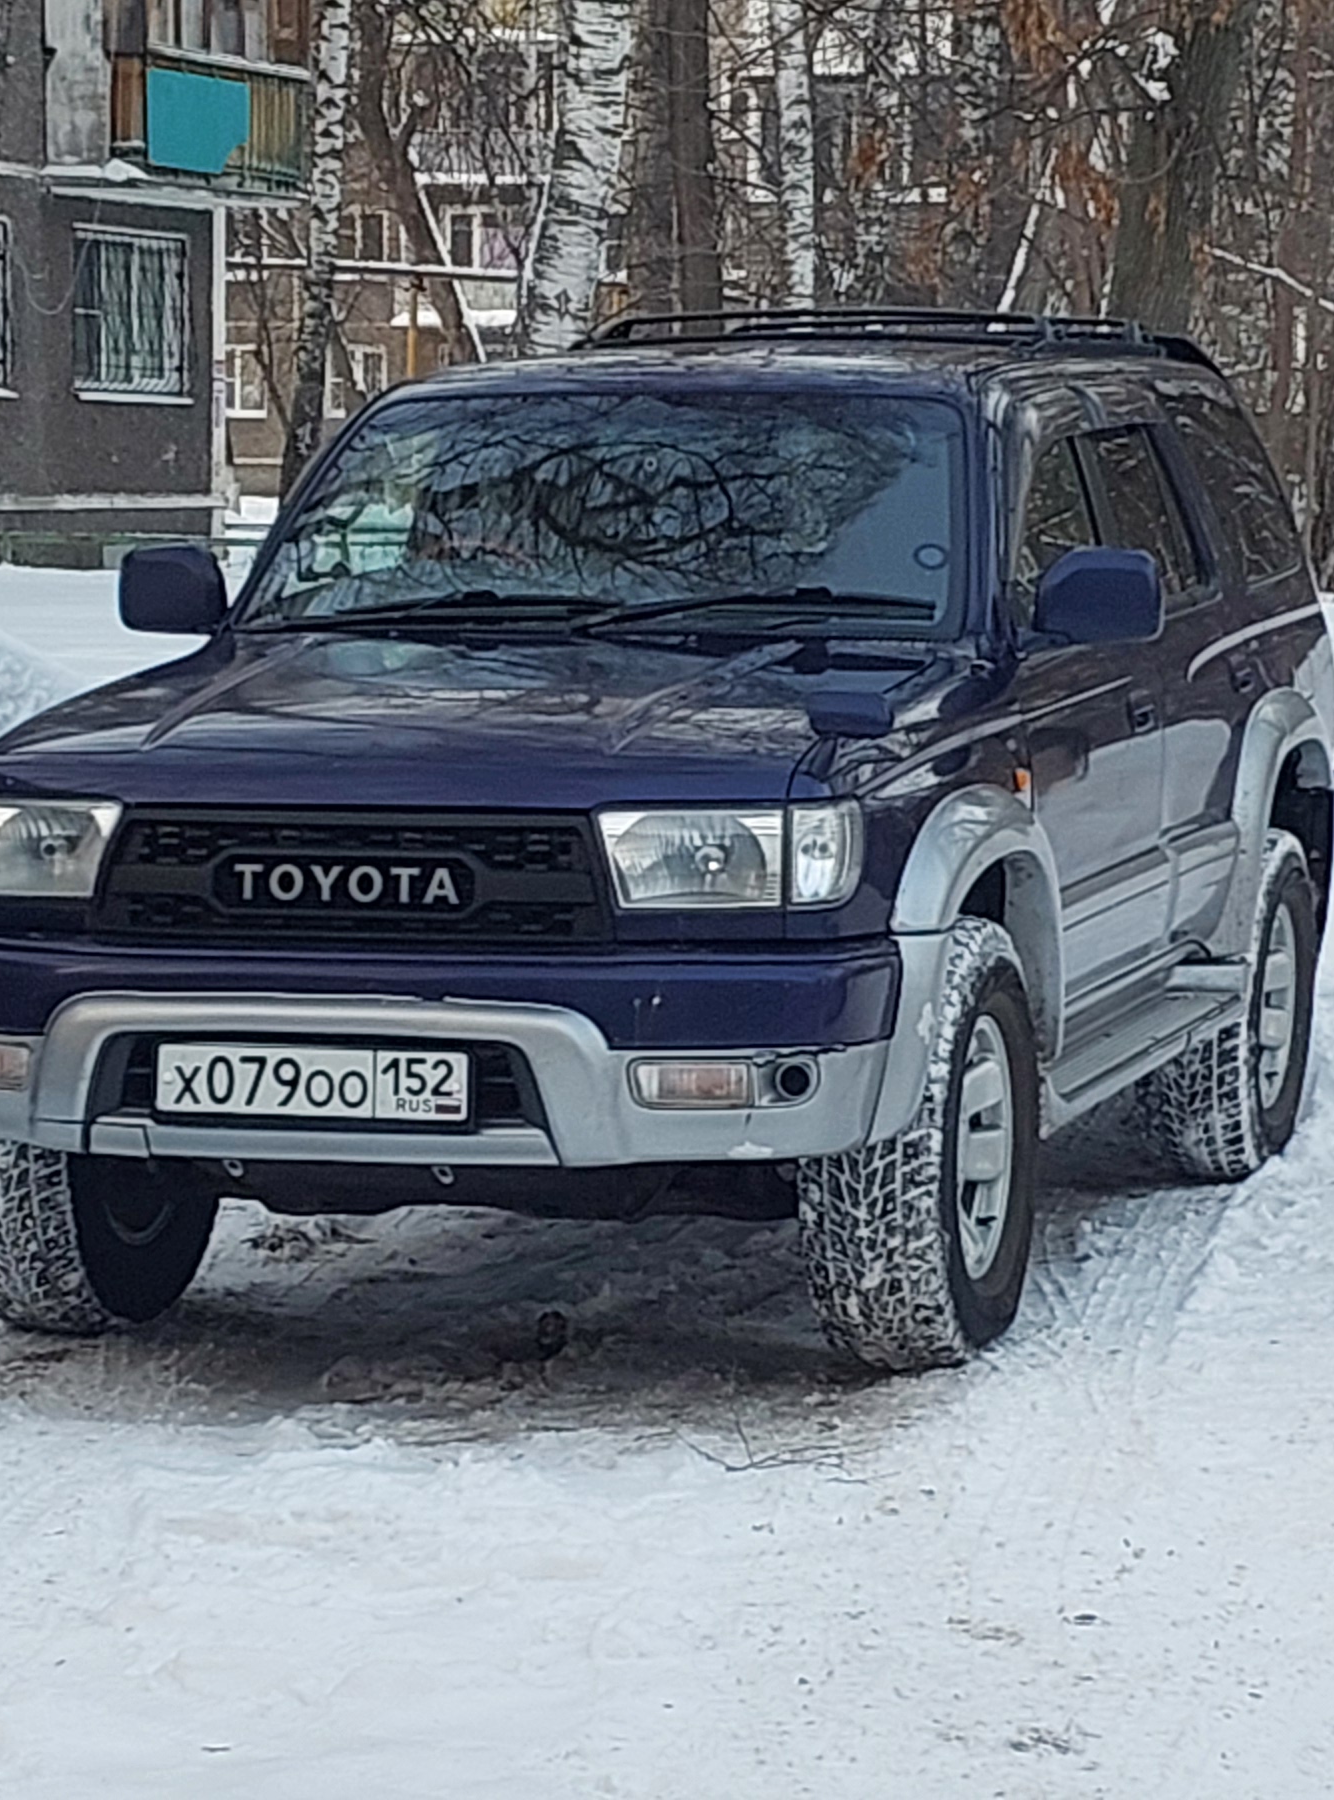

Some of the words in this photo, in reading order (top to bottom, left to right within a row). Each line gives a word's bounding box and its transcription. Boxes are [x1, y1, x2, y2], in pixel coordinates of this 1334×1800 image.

[233, 863, 460, 905] TOYOTA
[380, 1057, 454, 1097] 152
[395, 1097, 433, 1113] RUS
